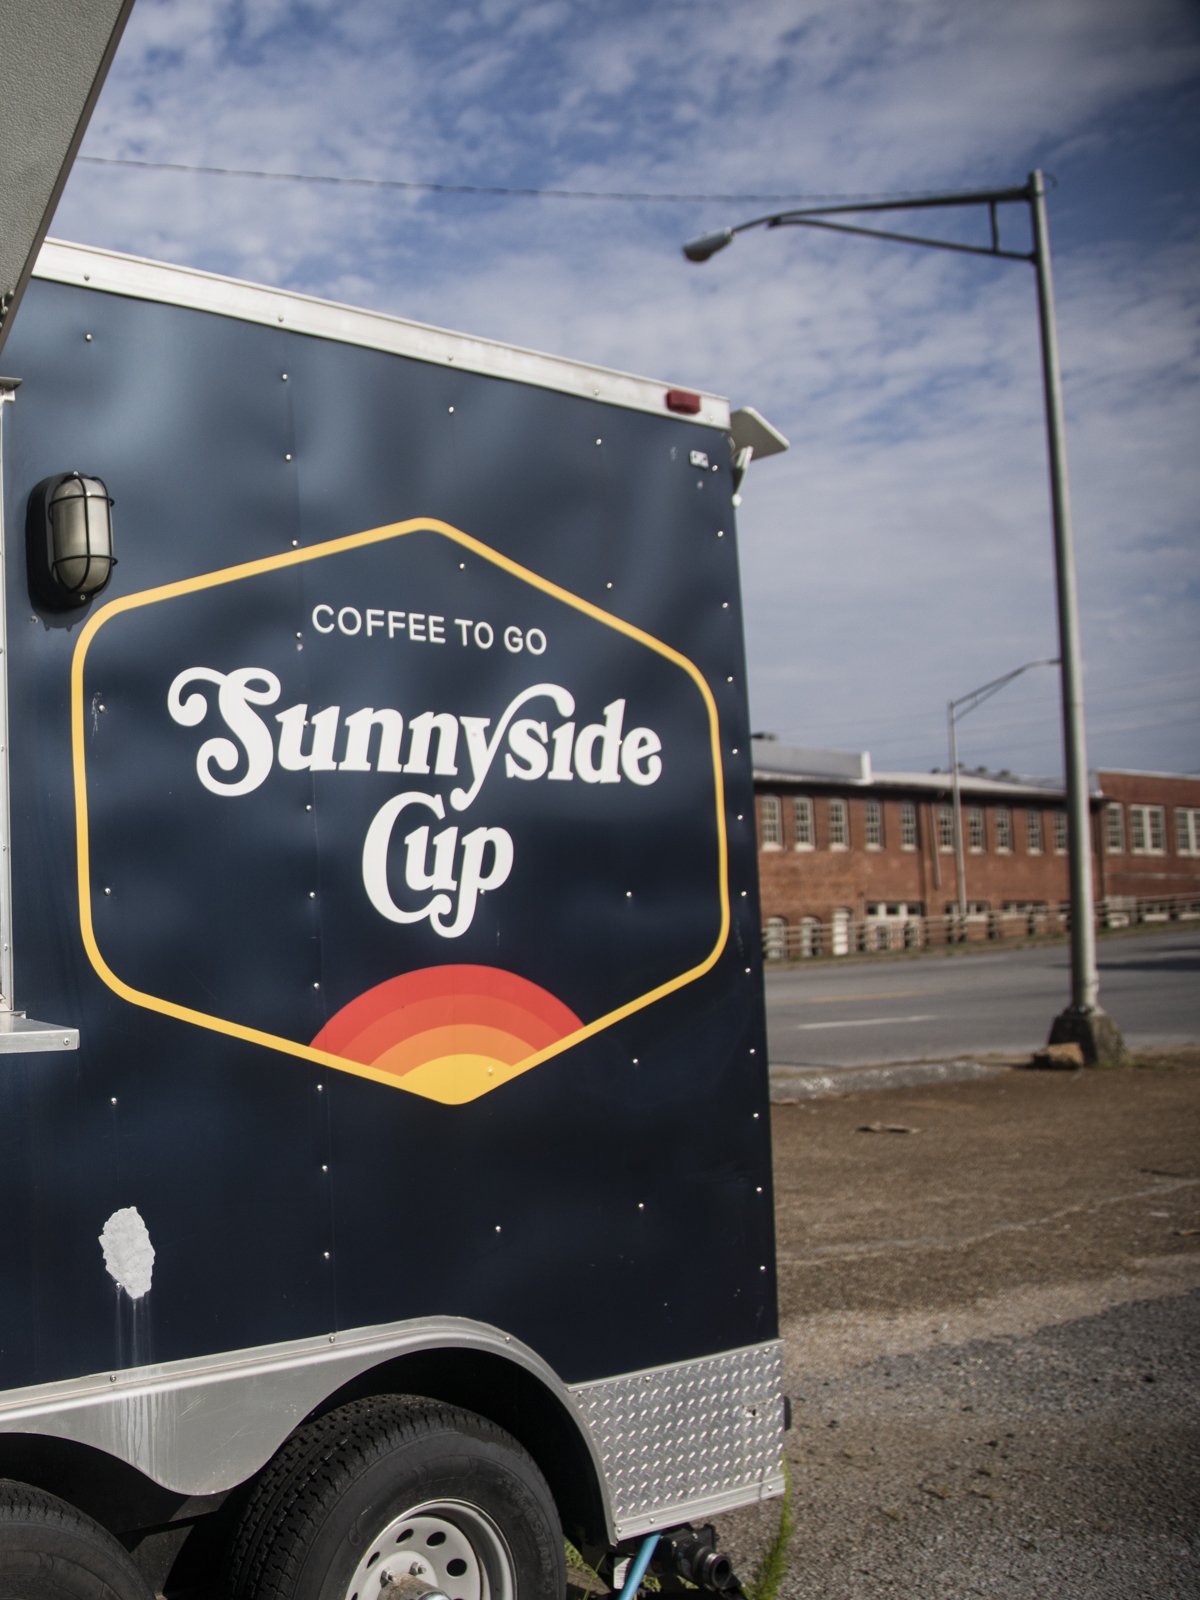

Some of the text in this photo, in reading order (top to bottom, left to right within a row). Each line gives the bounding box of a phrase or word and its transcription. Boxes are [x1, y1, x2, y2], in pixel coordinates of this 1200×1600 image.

[312, 604, 548, 656] COFFEE TO GO
[167, 667, 662, 811] Sunnyside
[362, 791, 514, 938] Cup
